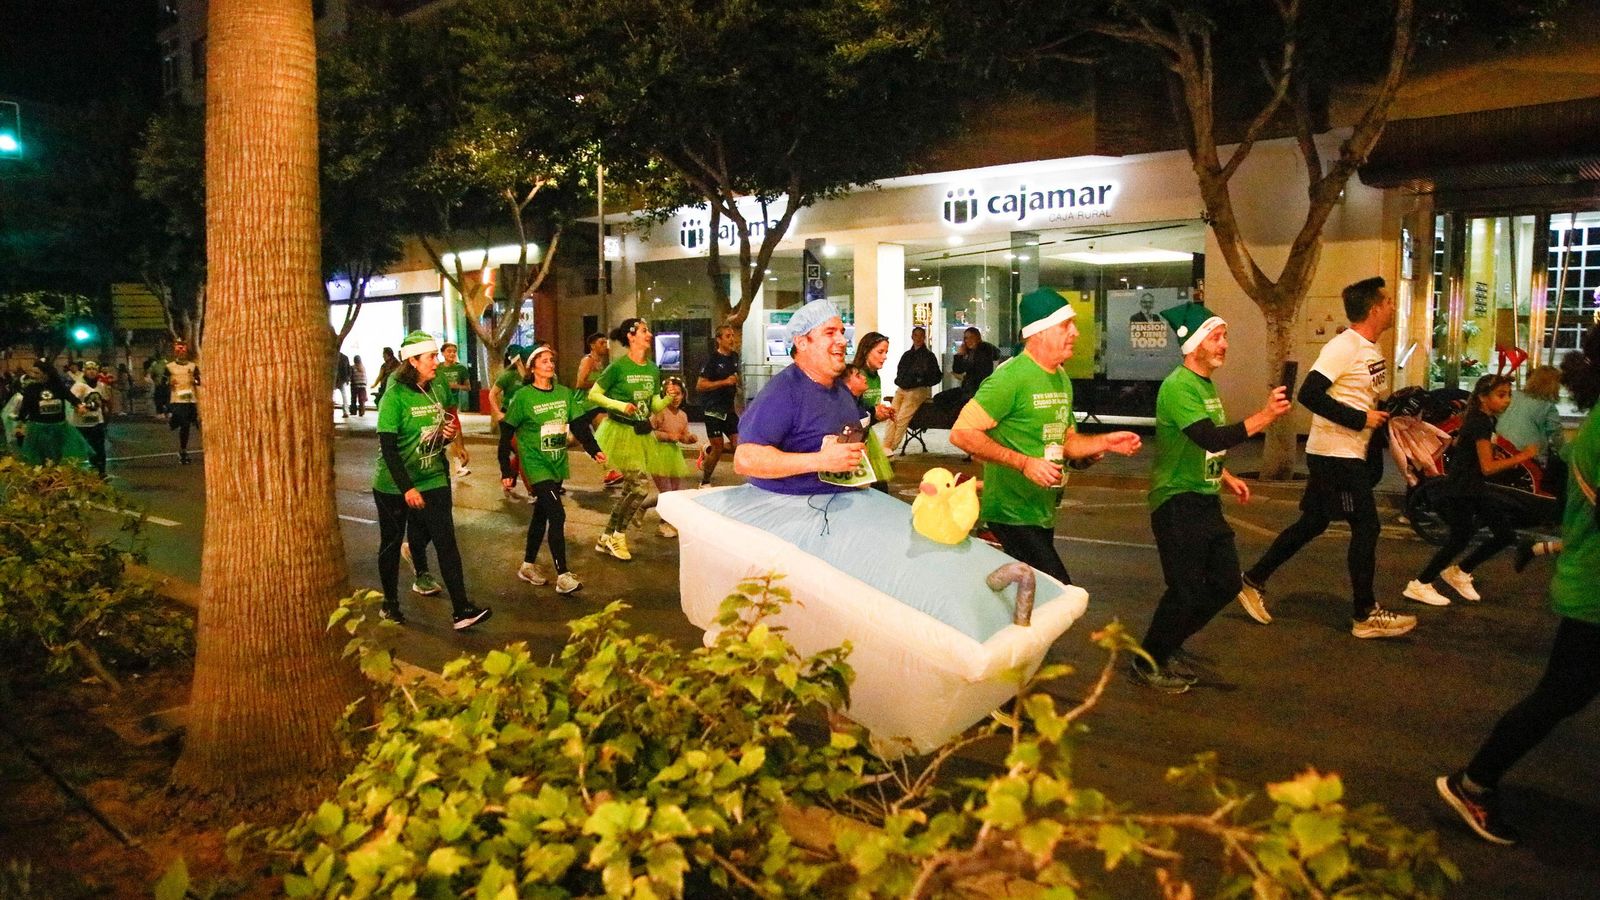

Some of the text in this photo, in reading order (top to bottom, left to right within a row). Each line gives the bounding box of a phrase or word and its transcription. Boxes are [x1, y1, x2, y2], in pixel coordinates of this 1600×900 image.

[987, 184, 1112, 221] cajamar
[1048, 209, 1112, 223] CAJA RURAL
[1131, 338, 1168, 348] TODO
